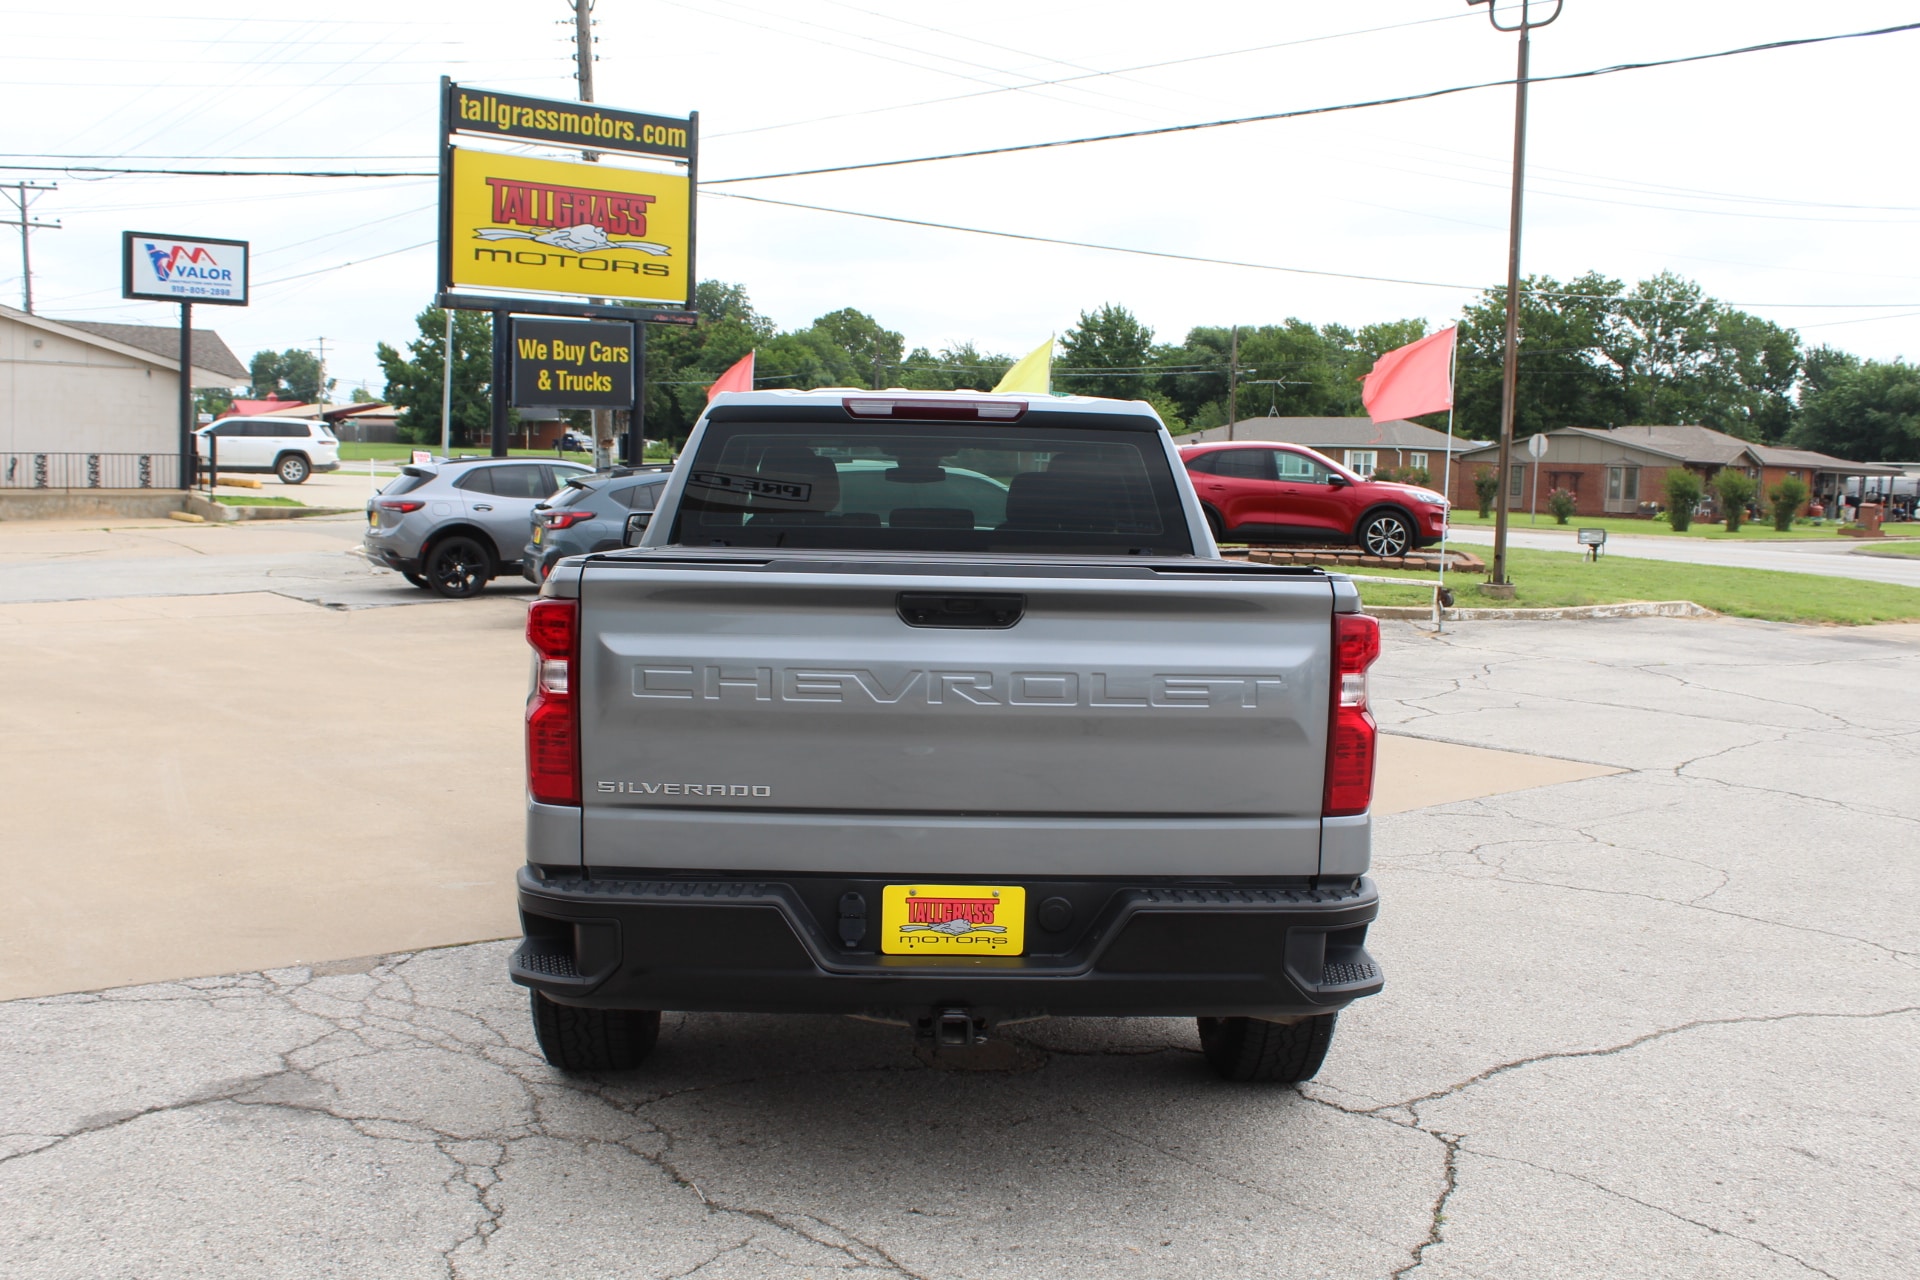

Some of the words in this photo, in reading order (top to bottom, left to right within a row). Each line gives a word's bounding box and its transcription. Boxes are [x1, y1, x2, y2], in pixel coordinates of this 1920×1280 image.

[459, 93, 687, 148] tallgrassmotors.com
[485, 177, 656, 237] TALLGRASS
[176, 265, 232, 281] VALOR
[474, 247, 670, 277] MOTORS
[518, 338, 548, 360] We
[553, 339, 586, 366] Buy
[590, 341, 629, 363] Cars
[538, 369, 552, 391] &
[555, 370, 612, 392] Trucks
[631, 664, 1282, 708] CHEVROLET
[597, 780, 771, 797] SILVERADO
[905, 897, 1000, 924] TALLGRASS
[899, 935, 1008, 945] MOTORS
